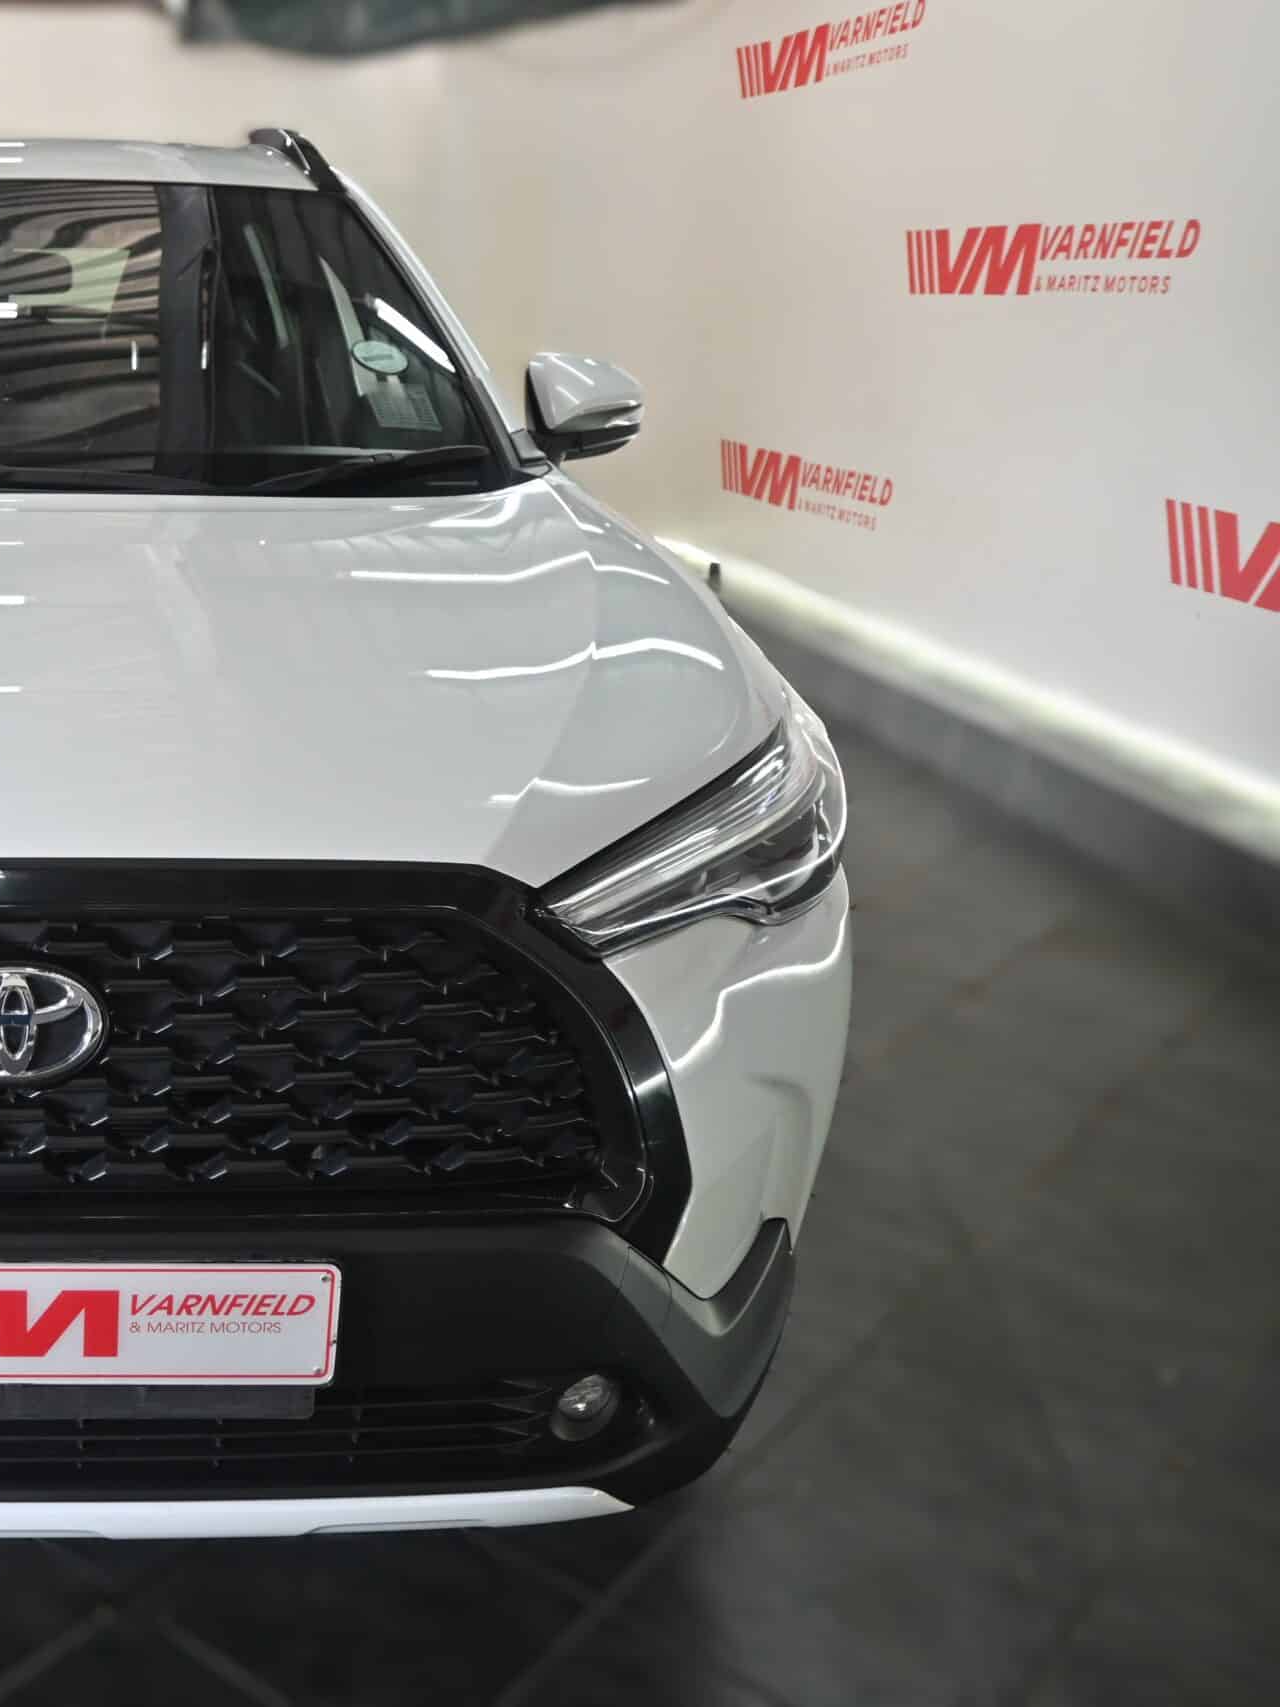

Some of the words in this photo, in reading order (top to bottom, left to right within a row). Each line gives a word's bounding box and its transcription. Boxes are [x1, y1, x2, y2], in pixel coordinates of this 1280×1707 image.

[829, 0, 926, 52] VARNFIELD
[761, 22, 830, 94] VM
[935, 223, 1042, 296] VM
[1039, 218, 1201, 261] VARNFIELD
[1046, 275, 1101, 293] MARITZ
[1105, 275, 1171, 294] MOTORS
[739, 443, 801, 511] VM
[801, 461, 893, 507] VARNFIELD
[128, 1321, 141, 1334] &
[146, 1321, 206, 1334] MARITZ
[210, 1321, 282, 1334] MOTORS
[129, 1293, 317, 1316] VARNFIELD
